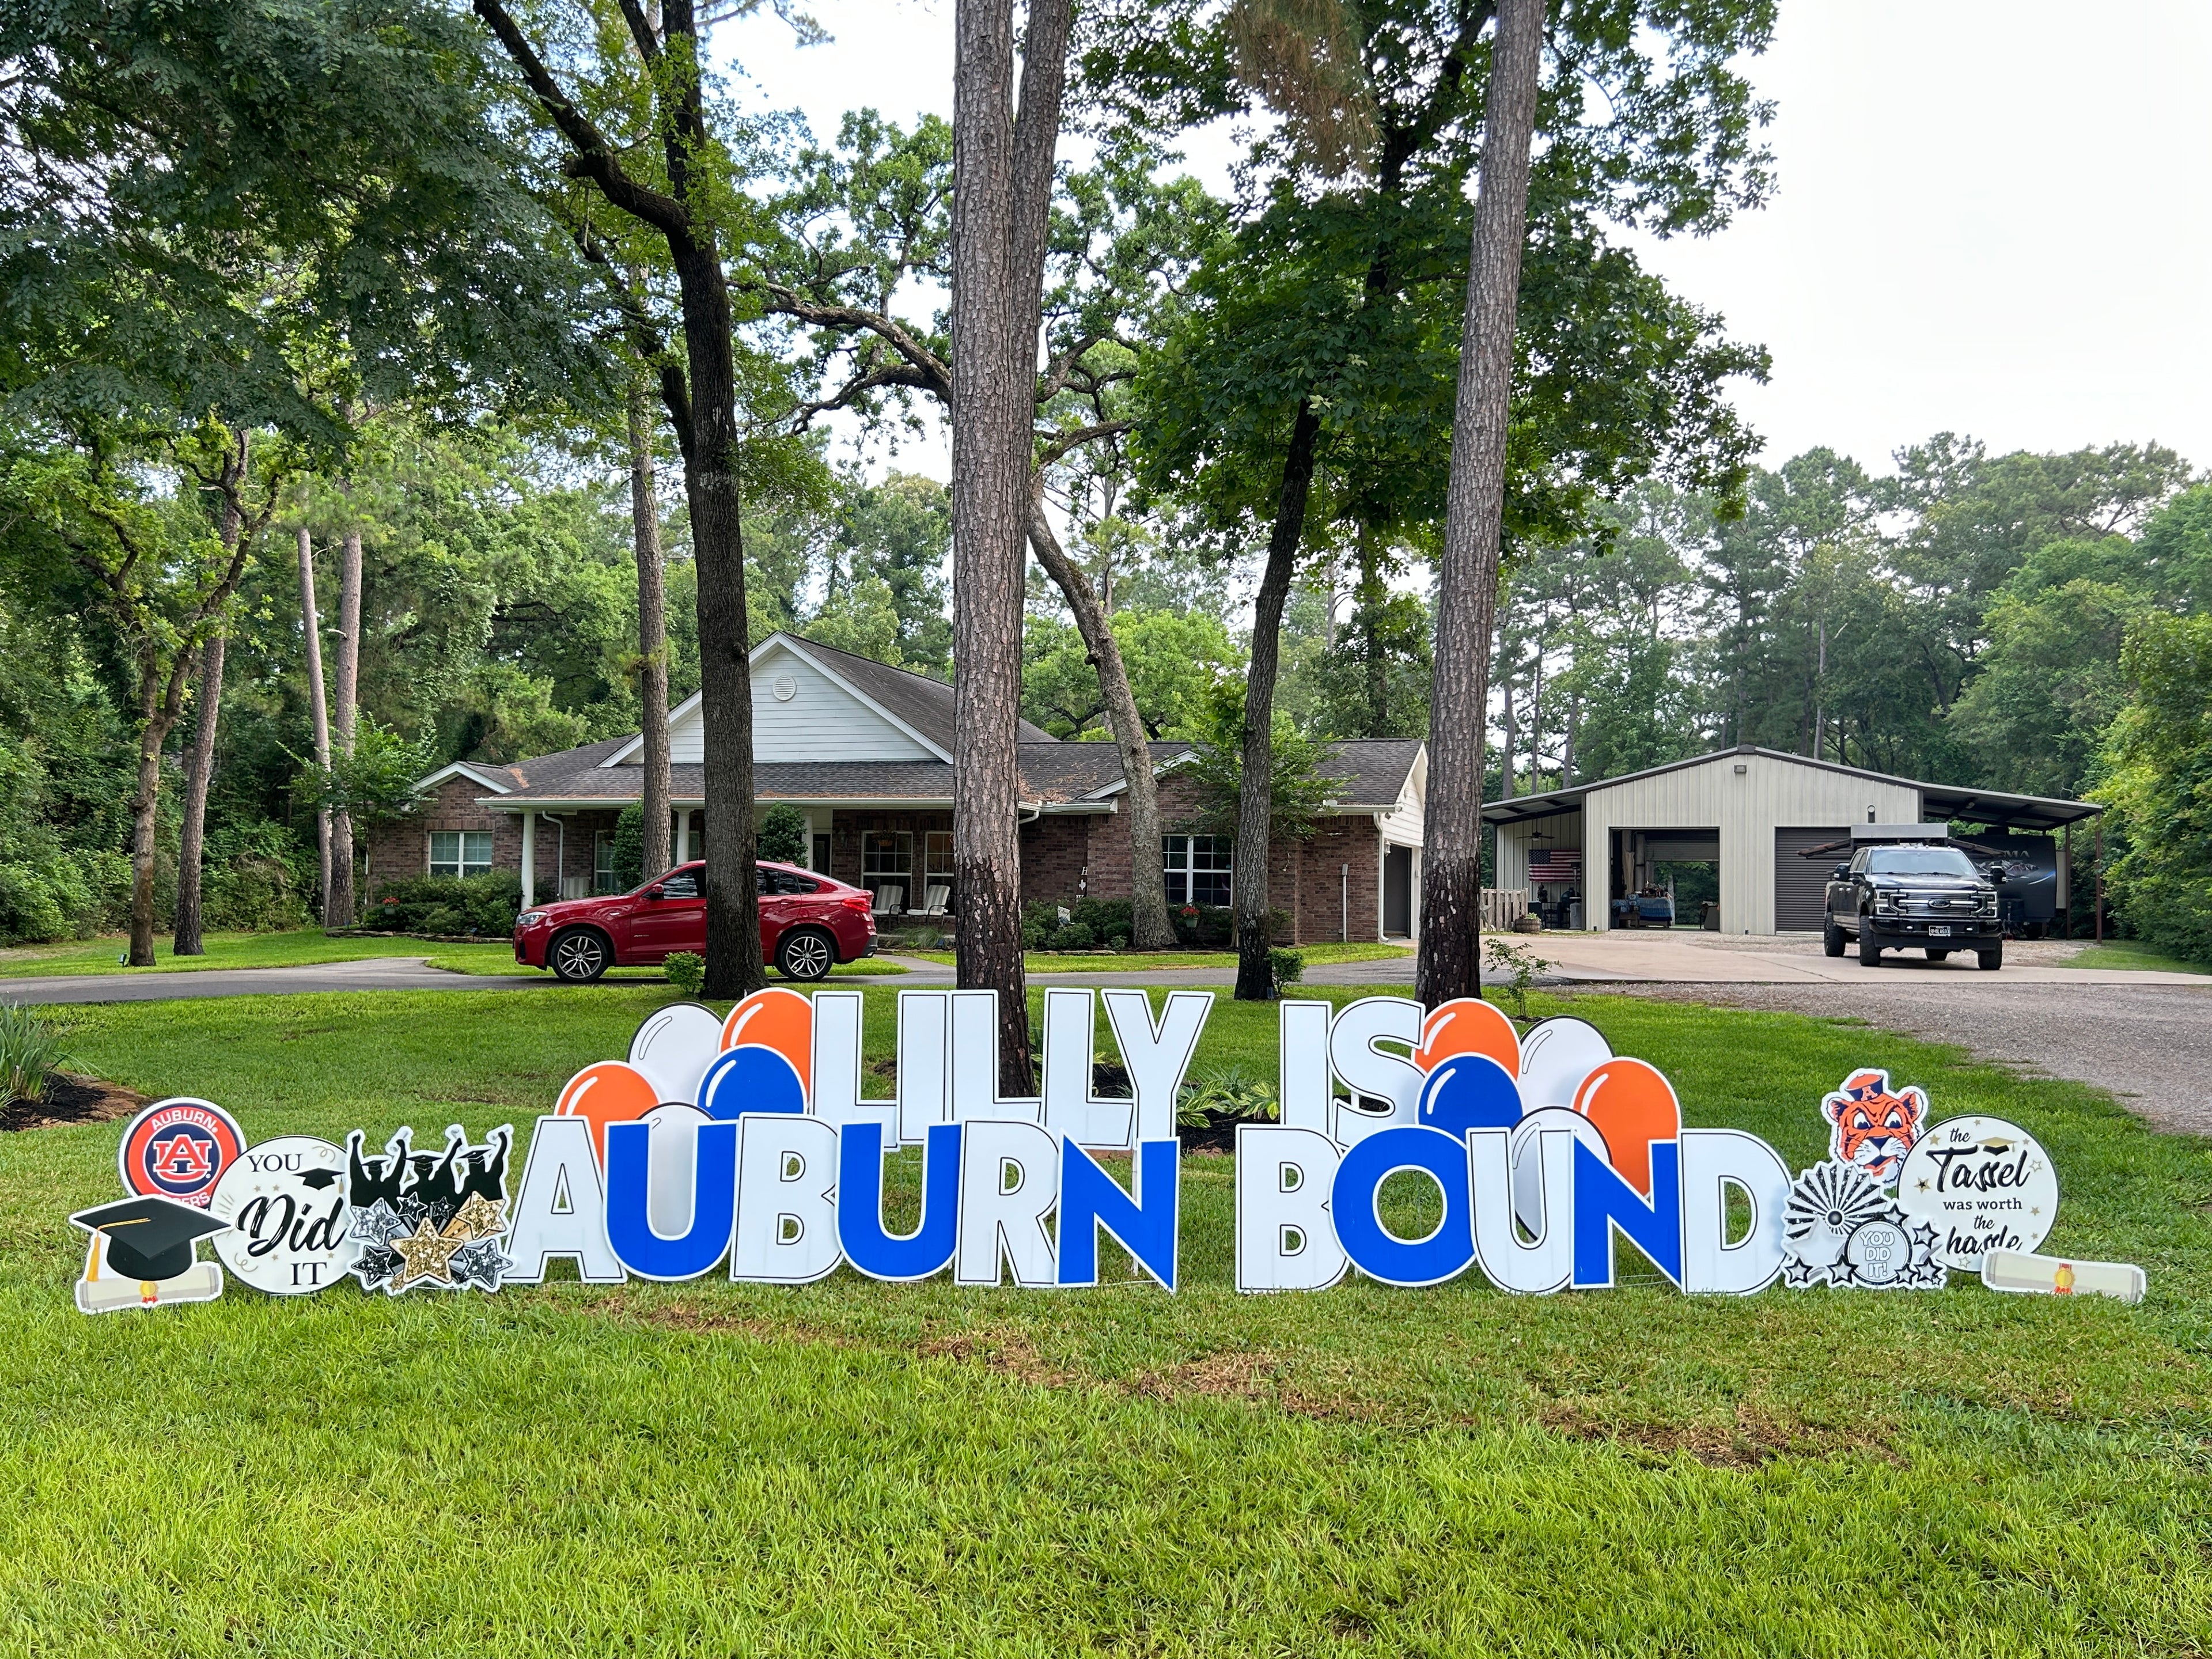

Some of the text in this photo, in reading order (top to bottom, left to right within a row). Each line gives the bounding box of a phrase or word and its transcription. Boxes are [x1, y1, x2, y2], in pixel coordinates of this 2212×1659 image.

[811, 987, 1426, 1151] LILLY IS
[1861, 1085, 1878, 1101] A
[151, 1109, 217, 1131] AUBURN
[1949, 1127, 1971, 1143] the
[247, 1153, 303, 1173] YOU
[1926, 1144, 2031, 1192] Tassel
[507, 1113, 1793, 1296] AUBURN BOUND
[1943, 1197, 2022, 1210] was worth
[235, 1194, 348, 1257] Did
[1974, 1214, 1995, 1230] the
[1859, 1230, 1895, 1247] YOU
[1865, 1246, 1891, 1262] DID
[290, 1262, 327, 1286] IT
[1868, 1262, 1888, 1278] IT!
